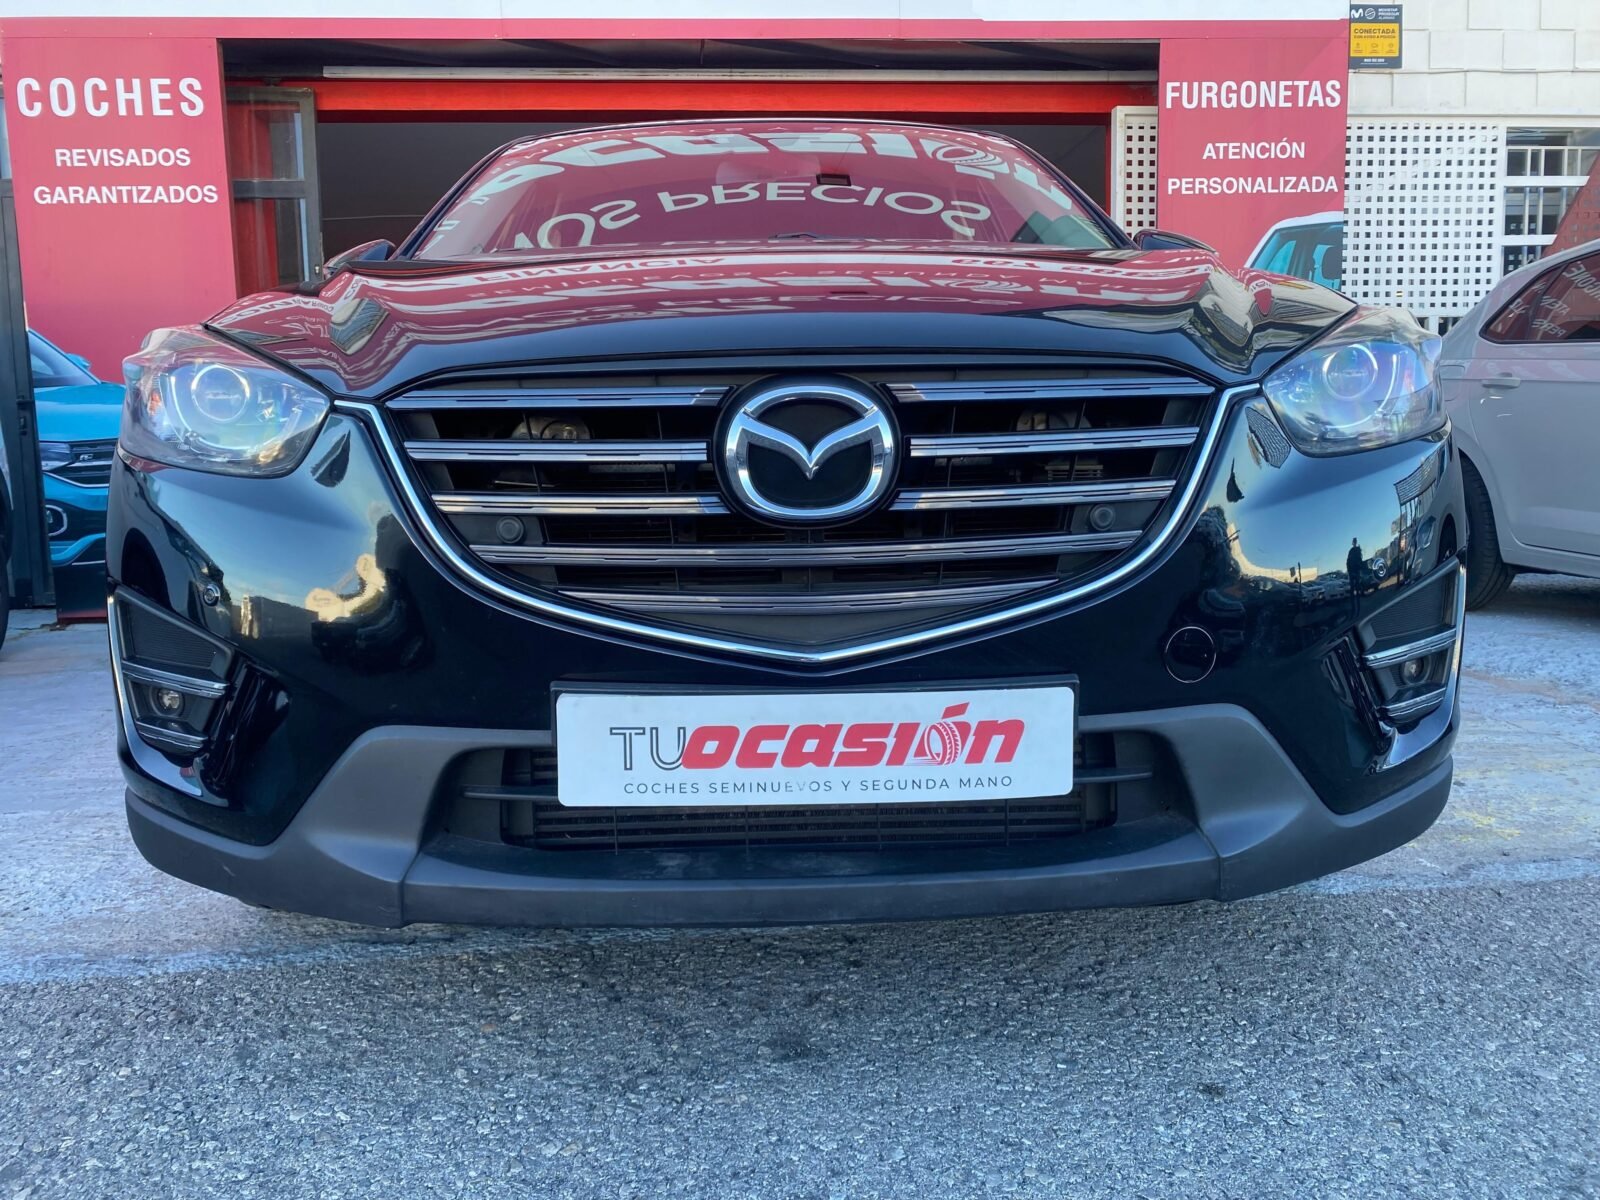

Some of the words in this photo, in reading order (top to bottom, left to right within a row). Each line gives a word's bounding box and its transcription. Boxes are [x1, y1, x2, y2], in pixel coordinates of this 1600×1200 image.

[16, 77, 205, 117] COCHES
[1165, 80, 1341, 109] FURGONETAS
[54, 148, 191, 167] REVISADOS
[1202, 137, 1306, 160] ATENCIÓN
[33, 185, 218, 205] GARANTIZADOS
[1167, 176, 1339, 195] PERSONALIZADA
[624, 782, 700, 794] COCHES
[708, 780, 832, 794] SEMINUEVOS
[841, 780, 851, 792] Y
[859, 778, 950, 792] SEGUNDA
[959, 775, 1013, 789] MANO
